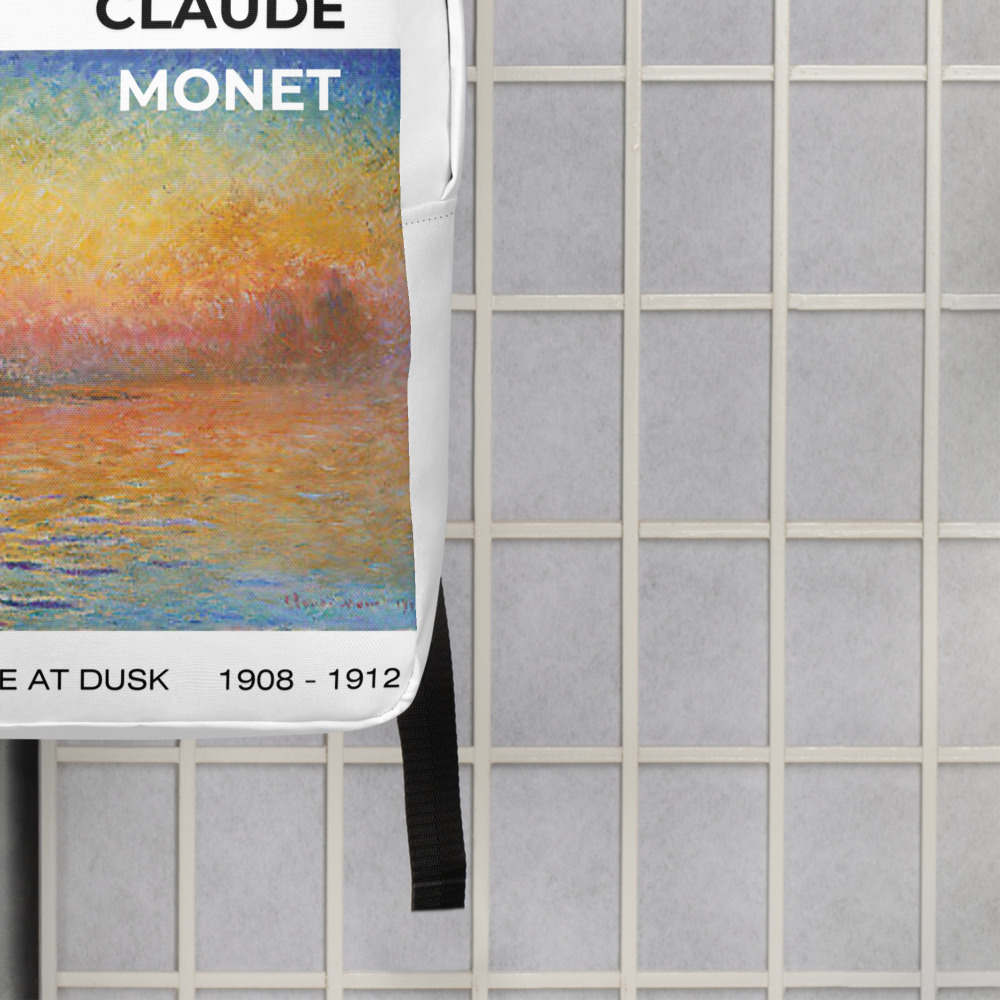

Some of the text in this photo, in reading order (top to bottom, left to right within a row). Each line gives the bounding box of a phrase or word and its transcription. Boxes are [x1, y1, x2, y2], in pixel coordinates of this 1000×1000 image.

[119, 68, 342, 112] MONET
[27, 667, 70, 691] AT
[80, 667, 169, 691] DUSK
[219, 667, 294, 691] 1908
[328, 667, 401, 691] 1912
